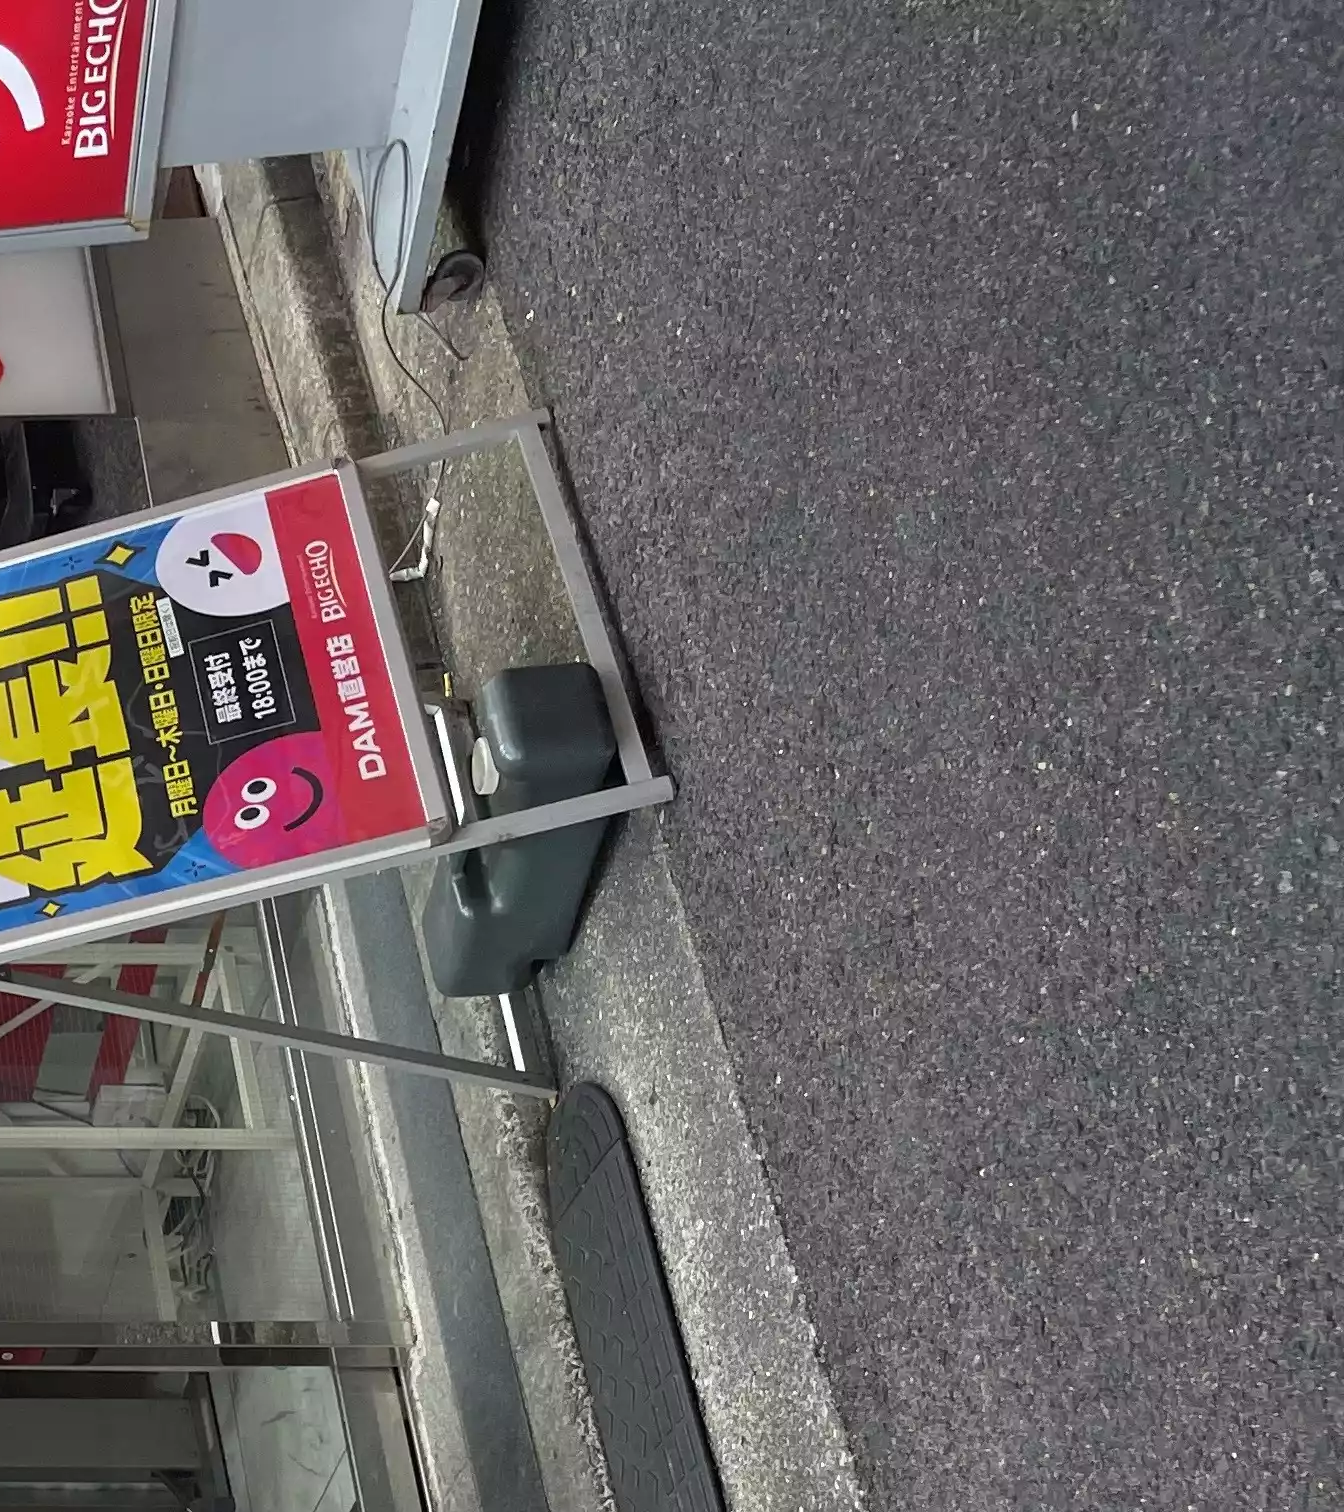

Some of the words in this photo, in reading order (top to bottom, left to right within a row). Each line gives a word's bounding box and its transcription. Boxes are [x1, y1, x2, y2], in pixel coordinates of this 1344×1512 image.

[66, 0, 84, 93] Entertainment
[60, 96, 76, 146] Karaoke
[73, 89, 109, 158] BIG
[304, 539, 334, 590] ECHO
[315, 589, 347, 623] BIG
[204, 651, 245, 724] 最終受付
[237, 635, 279, 721] 18:00まで
